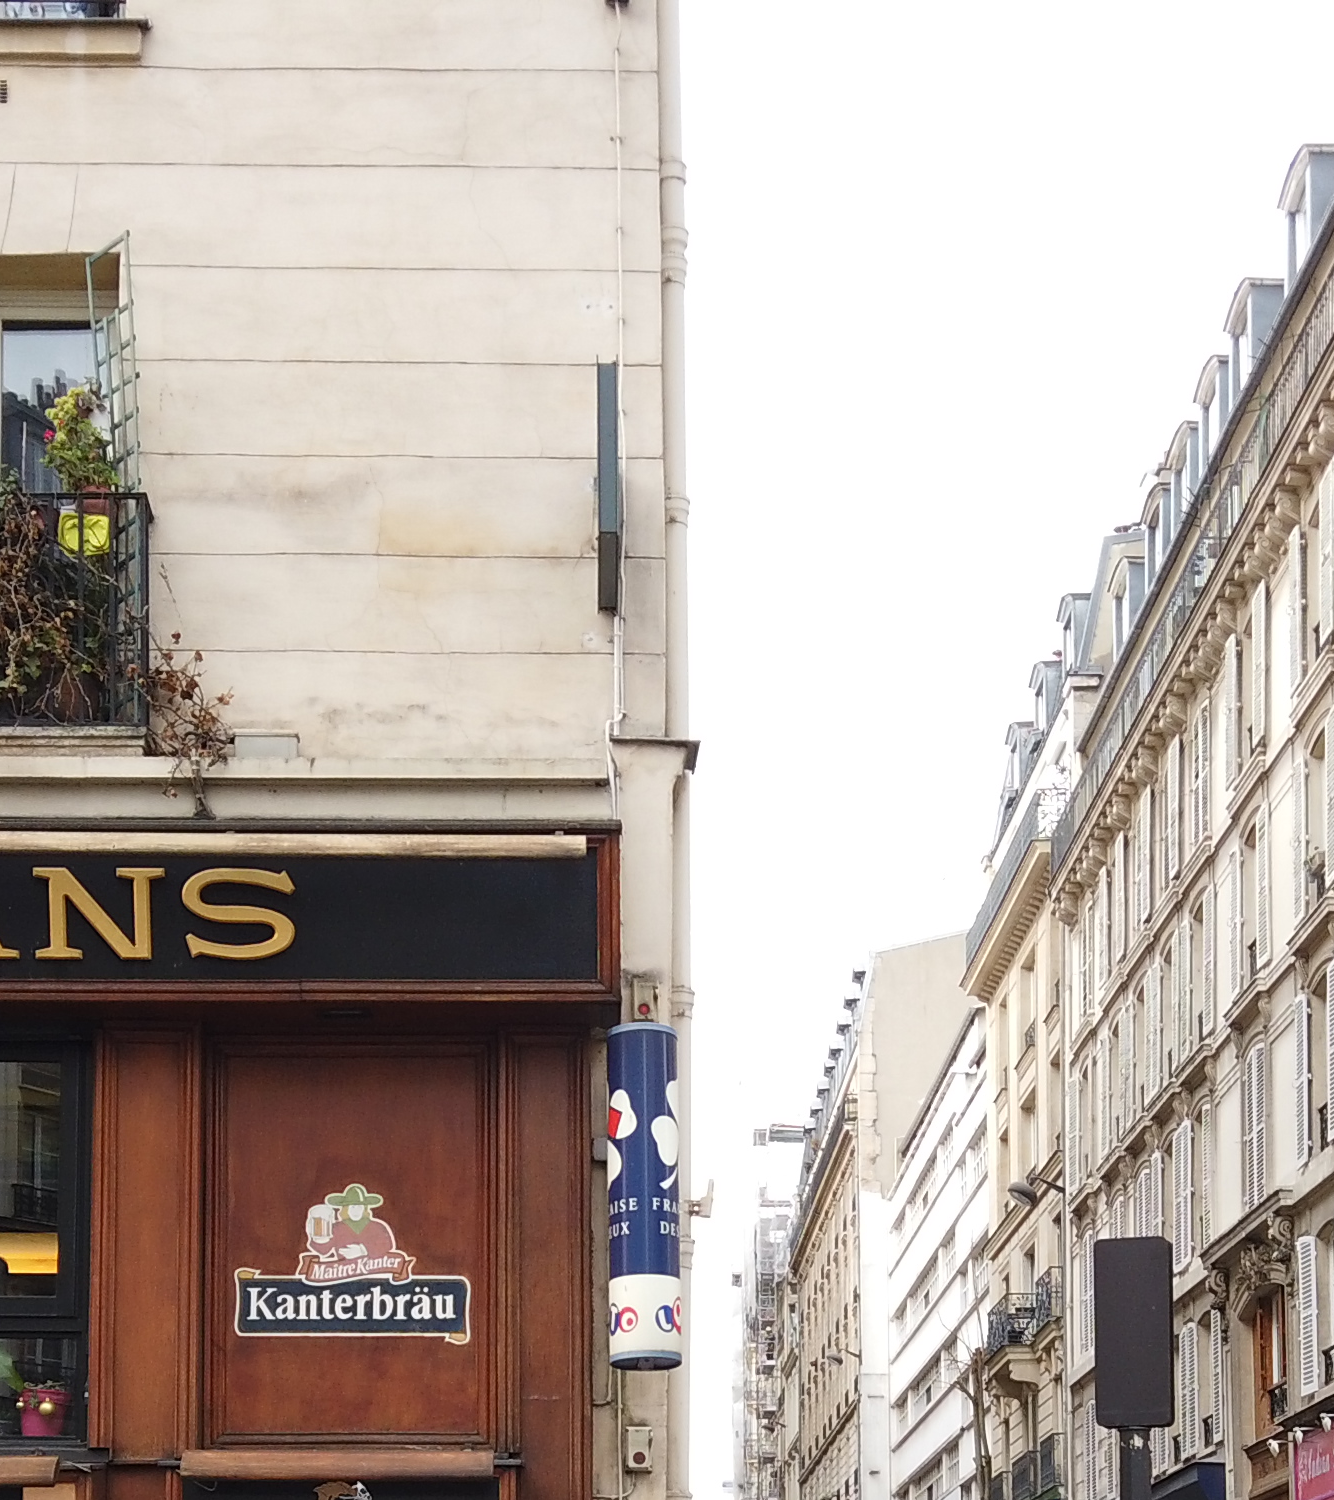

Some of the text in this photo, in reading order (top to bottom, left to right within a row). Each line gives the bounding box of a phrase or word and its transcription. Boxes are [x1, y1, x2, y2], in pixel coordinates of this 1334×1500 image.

[310, 1256, 402, 1280] Maître Kanter
[246, 1285, 457, 1321] Kanterbräu
[1308, 1444, 1330, 1479] Indian
